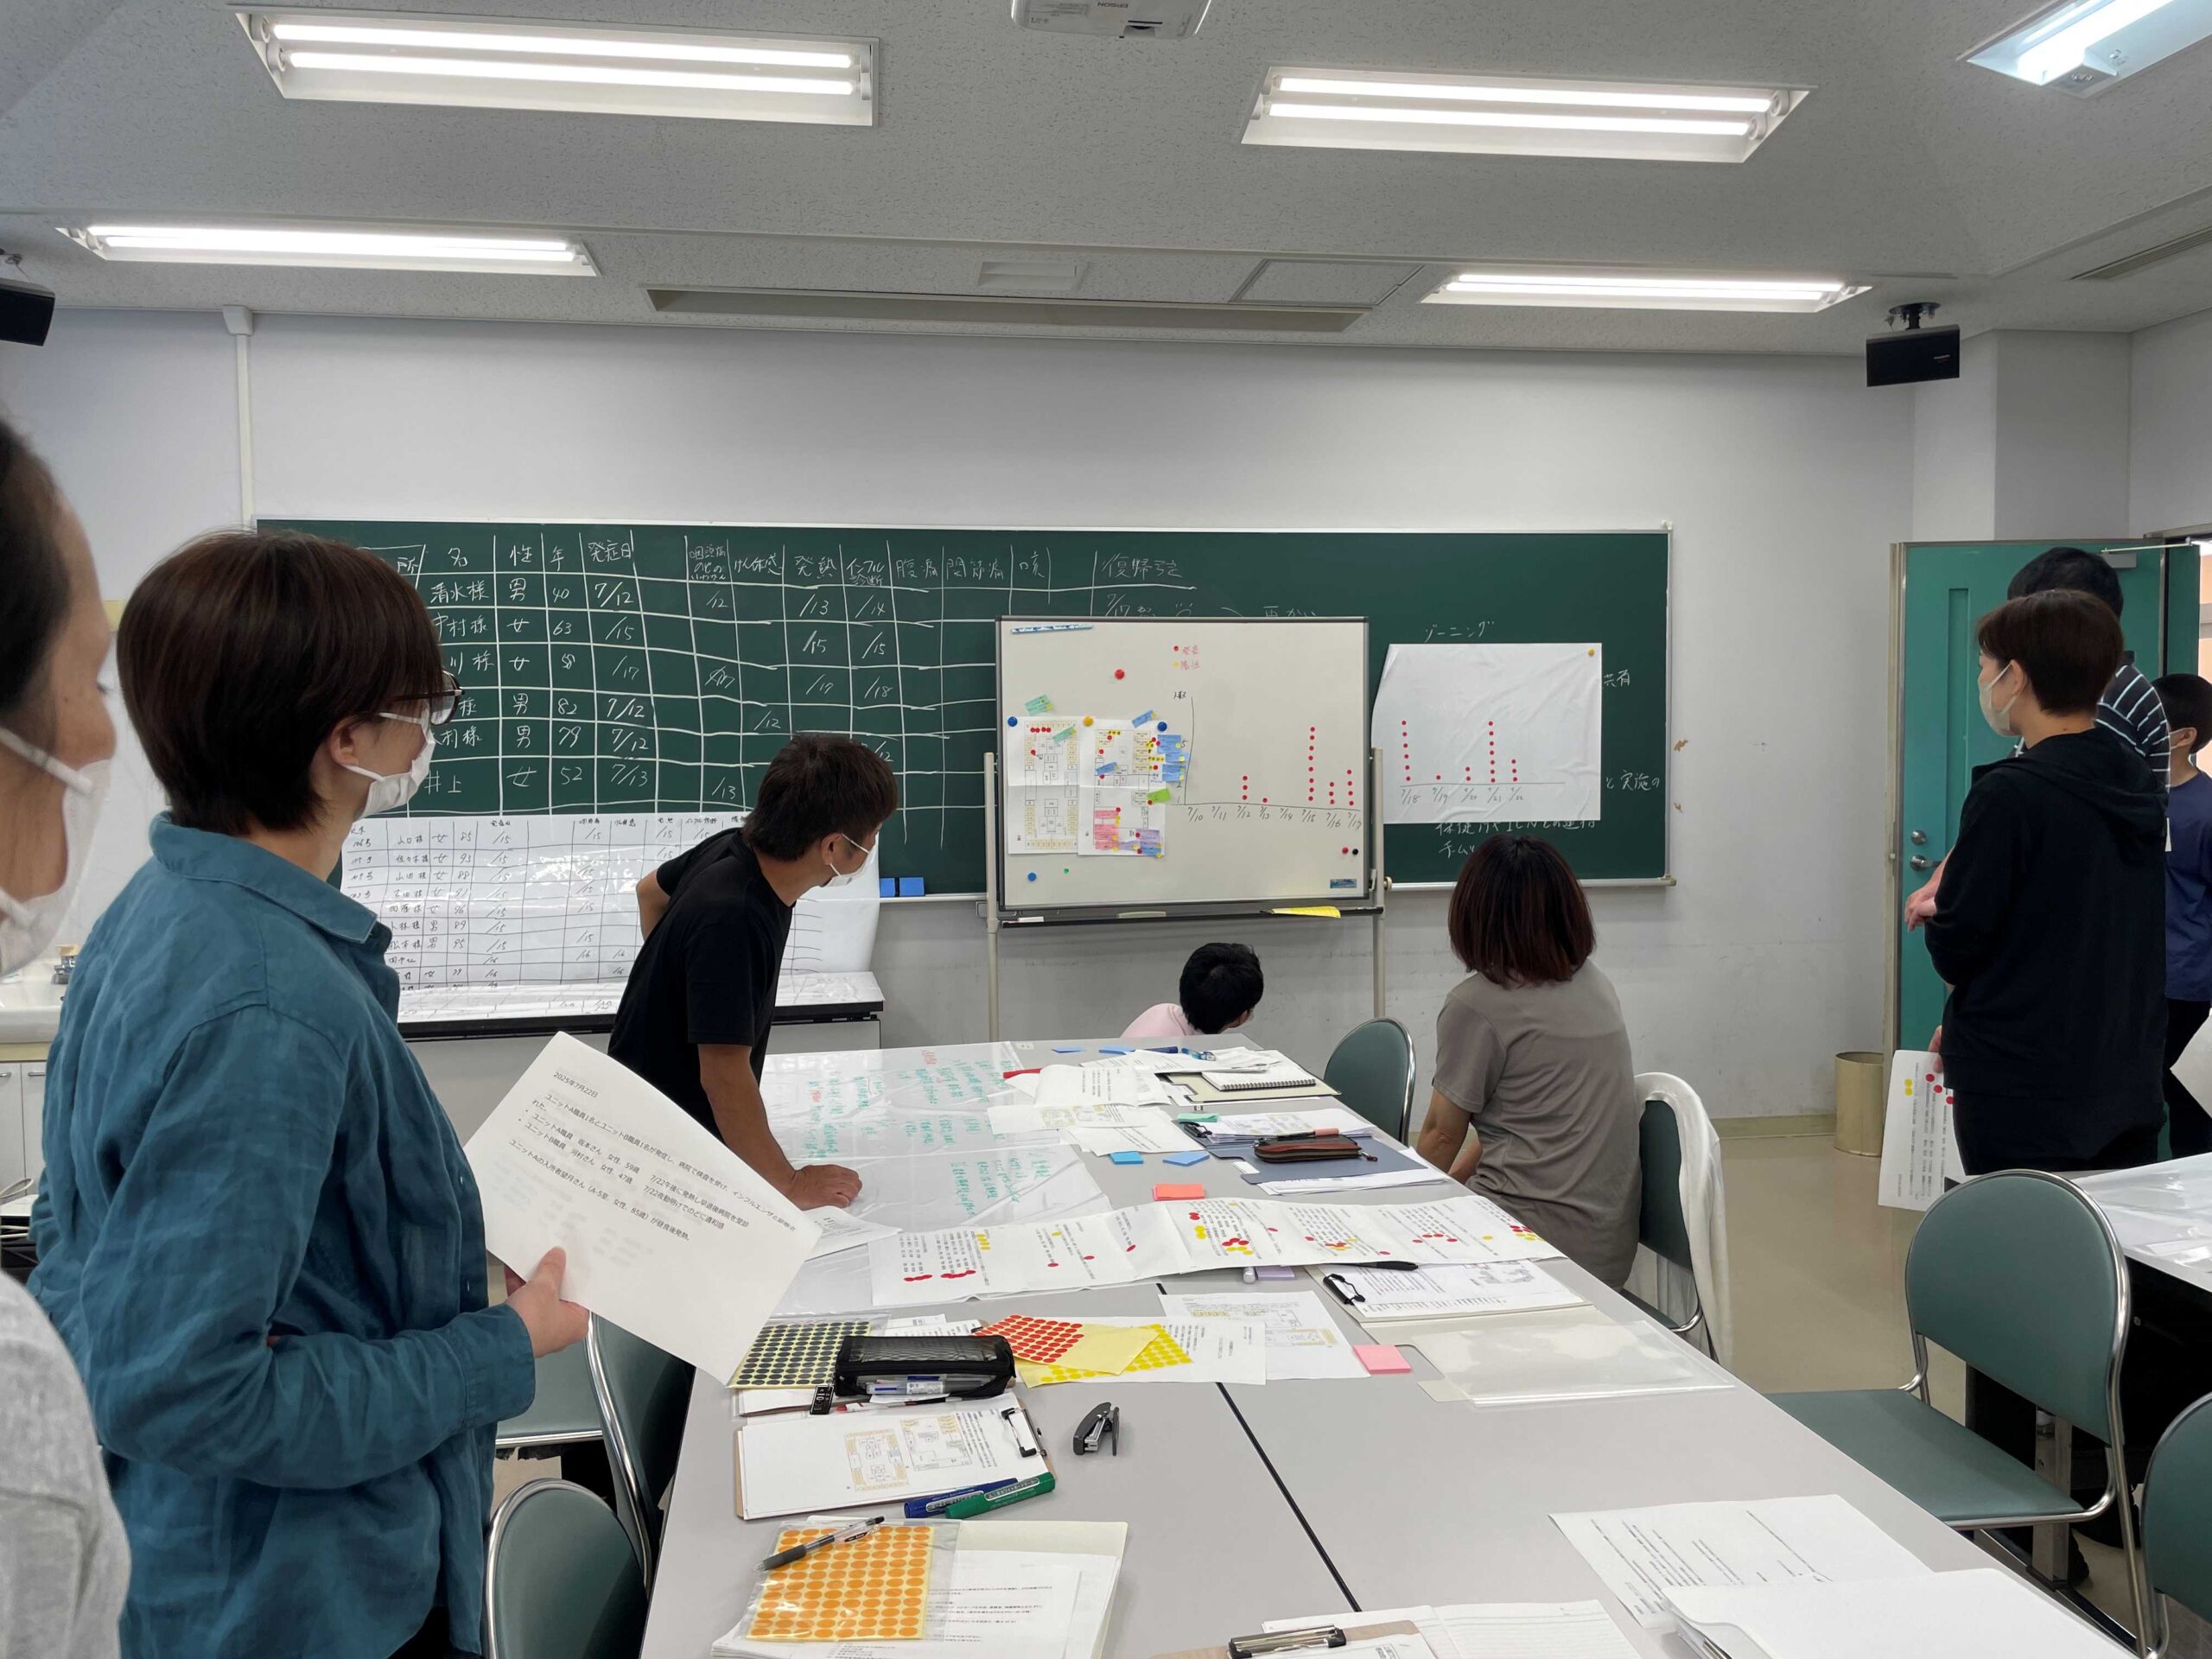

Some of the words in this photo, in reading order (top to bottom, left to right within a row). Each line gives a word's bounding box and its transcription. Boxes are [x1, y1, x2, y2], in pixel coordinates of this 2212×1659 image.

[448, 547, 468, 567] 名
[510, 544, 532, 566] 性
[550, 546, 565, 572] 年
[588, 540, 632, 563] 発症日
[795, 556, 836, 579] 発熱
[847, 558, 885, 576] インフル
[1102, 553, 1183, 580] 復帰予定
[430, 581, 490, 604] 清水様
[510, 578, 526, 601] 男
[553, 588, 569, 601] 40
[594, 582, 635, 607] 7/12
[800, 594, 830, 616] /13
[855, 595, 885, 618] /14
[507, 619, 529, 632] 女
[553, 621, 572, 635] 63
[606, 616, 635, 640] /15
[862, 632, 886, 658] /15
[509, 657, 530, 671] 女
[865, 677, 893, 698] /18
[1603, 669, 1630, 688] 共有
[513, 693, 529, 715] 男
[558, 699, 577, 715] 82
[607, 697, 645, 721] 7/12
[517, 726, 531, 748] 男
[559, 726, 582, 748] 79
[612, 728, 649, 752] 7/12
[423, 771, 462, 794] 井上
[506, 766, 537, 787] 女
[561, 766, 582, 785] 52
[611, 764, 648, 787] 7/13
[712, 777, 736, 799] /13
[1400, 787, 1421, 804] 7/18
[1432, 787, 1450, 803] 7/19
[1187, 806, 1204, 822] 7/10
[1211, 805, 1227, 821] 7/11
[1236, 804, 1251, 819] 7/12
[1259, 805, 1270, 820] 7/13
[1280, 807, 1293, 821] 7/14
[1326, 812, 1341, 828] 7/16
[1348, 811, 1362, 830] 7/17
[432, 834, 448, 843] 女
[434, 854, 448, 863] 女
[460, 853, 472, 864] 93
[434, 870, 448, 880] 女
[454, 905, 467, 914] 96
[454, 919, 467, 930] 89
[453, 938, 465, 949] 95
[553, 1071, 599, 1098] 2025年7月22日
